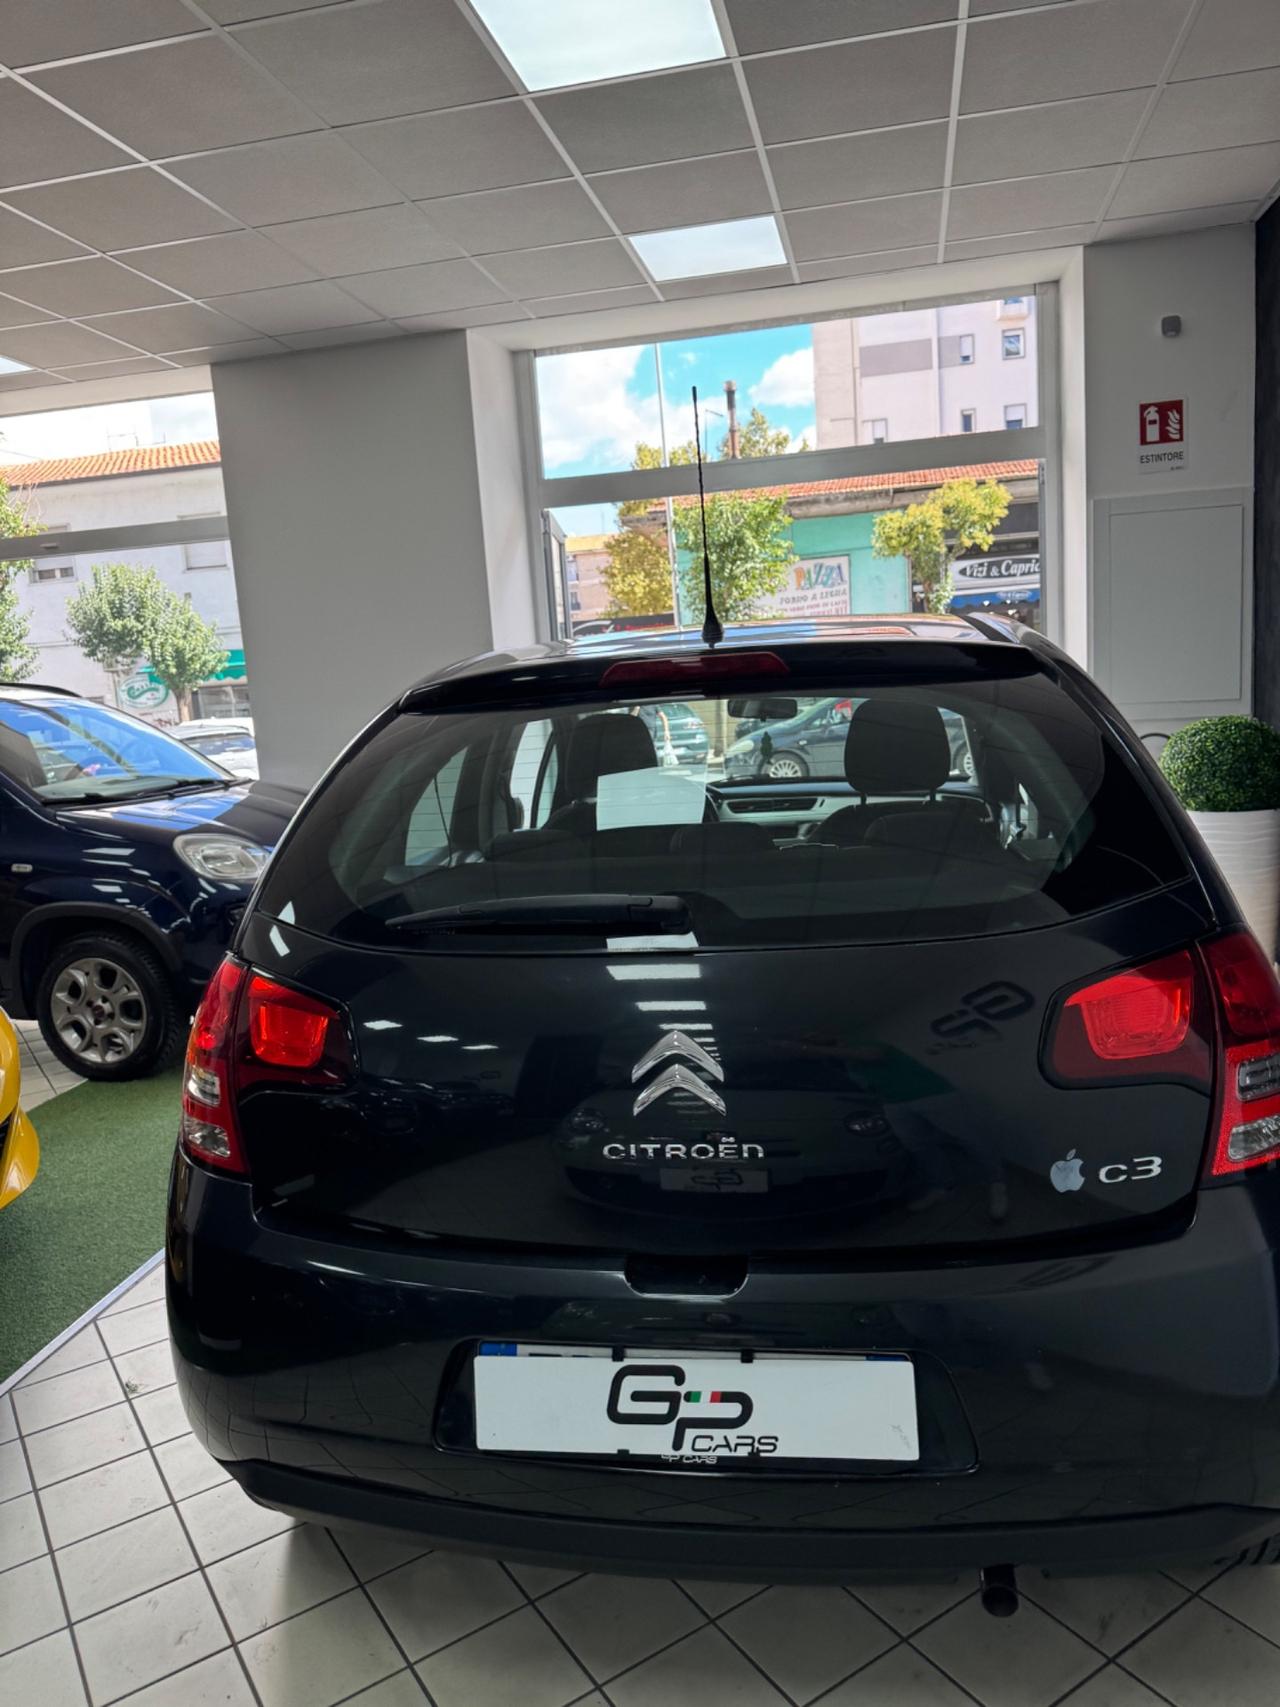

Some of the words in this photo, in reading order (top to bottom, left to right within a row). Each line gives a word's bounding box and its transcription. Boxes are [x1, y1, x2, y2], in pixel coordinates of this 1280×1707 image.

[1140, 450, 1184, 464] ESTINTORE
[793, 562, 846, 590] PAZZA
[965, 562, 988, 577] Vizi
[990, 565, 1000, 577] &
[602, 1136, 765, 1159] CITROËN
[607, 1364, 753, 1452] GP
[691, 1434, 779, 1454] CARS
[683, 1455, 718, 1464] CARS
